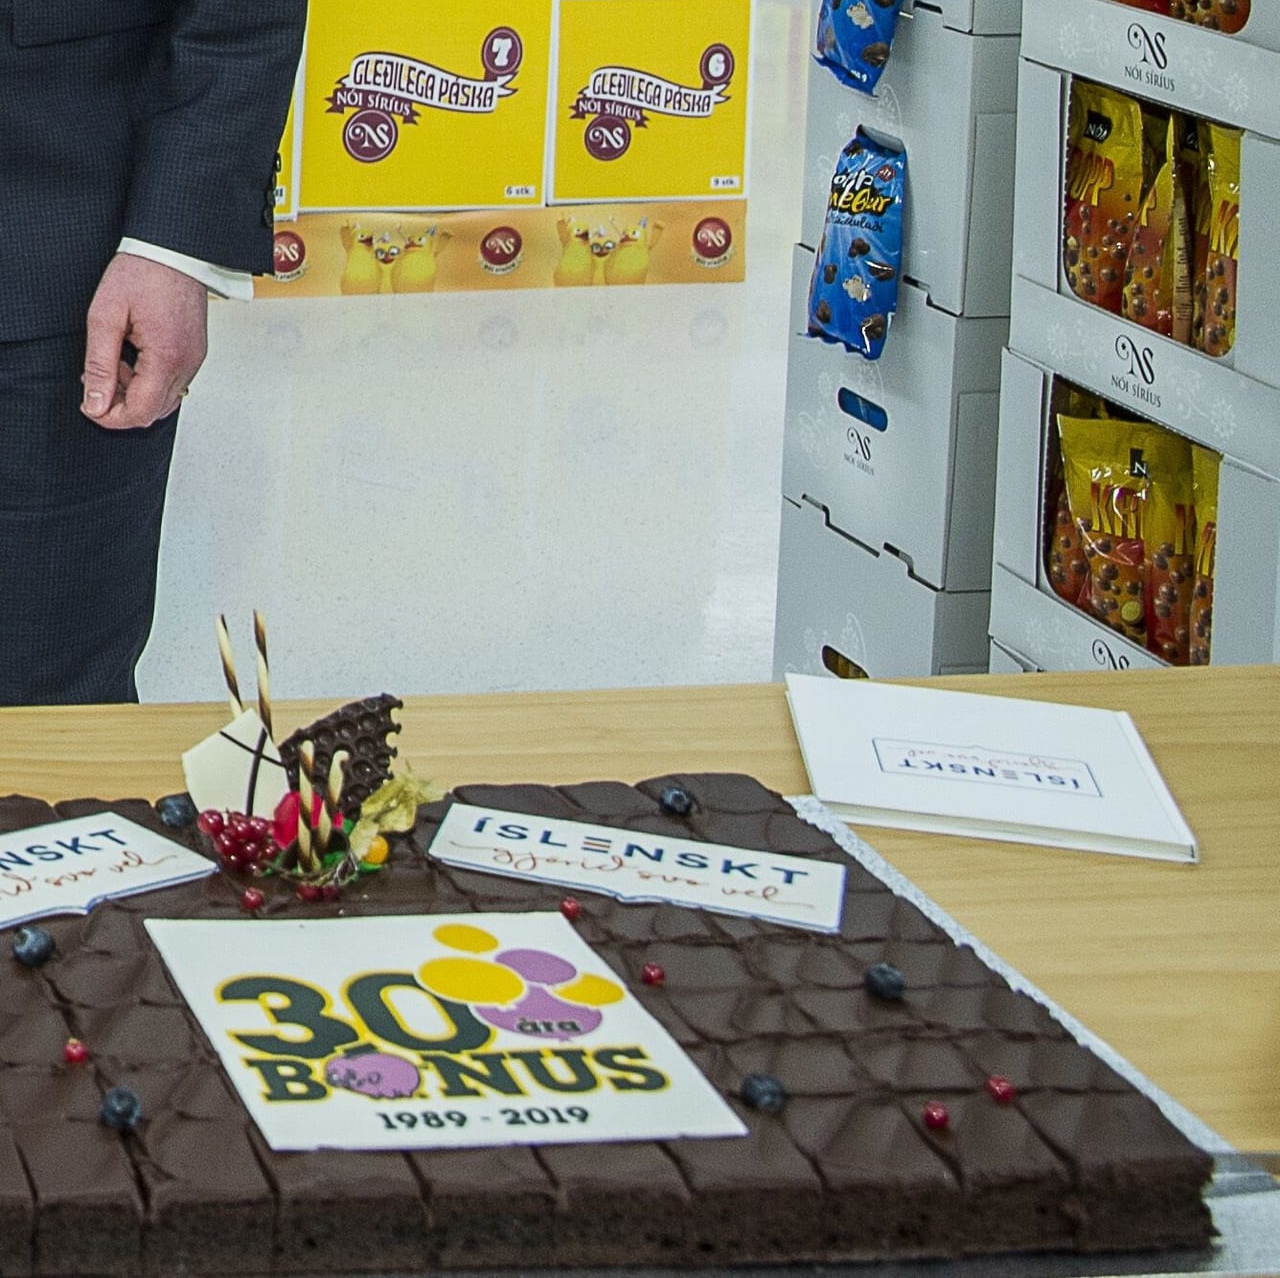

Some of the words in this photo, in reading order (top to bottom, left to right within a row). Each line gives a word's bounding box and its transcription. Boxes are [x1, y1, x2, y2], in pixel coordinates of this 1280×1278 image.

[491, 37, 513, 67] 7
[707, 52, 726, 78] 6
[352, 59, 435, 101] GLEÐILEGA
[438, 76, 494, 108] PÁSKA
[592, 72, 661, 107] GLEÐILEGA
[664, 85, 712, 113] PÁSKA
[1124, 65, 1143, 81] NÓI
[1145, 69, 1175, 92] SÍRÍUS
[336, 90, 363, 107] NÓI
[367, 92, 411, 116] SÍRÍUS
[578, 99, 602, 113] NÓI
[604, 102, 641, 120] SÍRÍUS
[1111, 375, 1130, 393] NÓI
[1132, 382, 1162, 408] SÍRÍUS
[472, 816, 809, 885] ÍSLENSKT
[44, 866, 98, 887] svo
[112, 850, 178, 874] vel
[639, 868, 713, 886] svo
[721, 884, 815, 909] vel
[216, 972, 494, 1058] 30
[517, 1015, 582, 1036] ára
[377, 1109, 469, 1133] 1989
[500, 1105, 592, 1129] 2019
